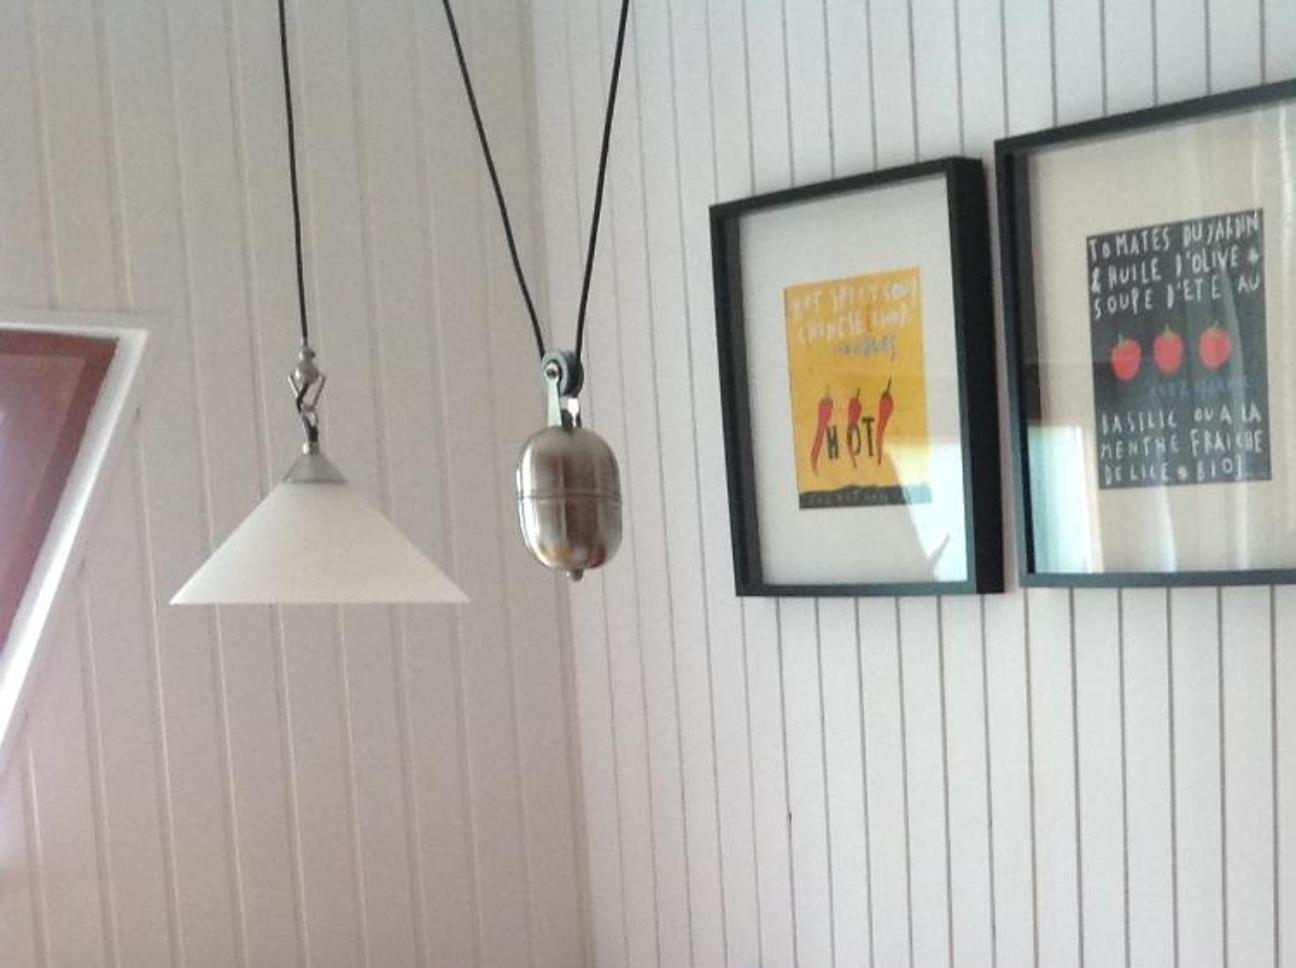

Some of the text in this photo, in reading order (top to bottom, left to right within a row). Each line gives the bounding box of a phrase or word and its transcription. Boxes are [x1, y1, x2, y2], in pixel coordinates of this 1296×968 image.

[1089, 227, 1171, 262] TOMATES
[1183, 223, 1203, 248] DU
[1108, 258, 1162, 290] HUILE
[1175, 246, 1239, 278] D'OLIVE
[1094, 288, 1154, 319] SOUPE
[1238, 272, 1260, 292] AU
[827, 416, 875, 460] HOT
[1102, 410, 1177, 436] BASILIC
[1194, 407, 1214, 422] OU
[1242, 402, 1262, 423] LA
[1101, 432, 1179, 460] MENTHE
